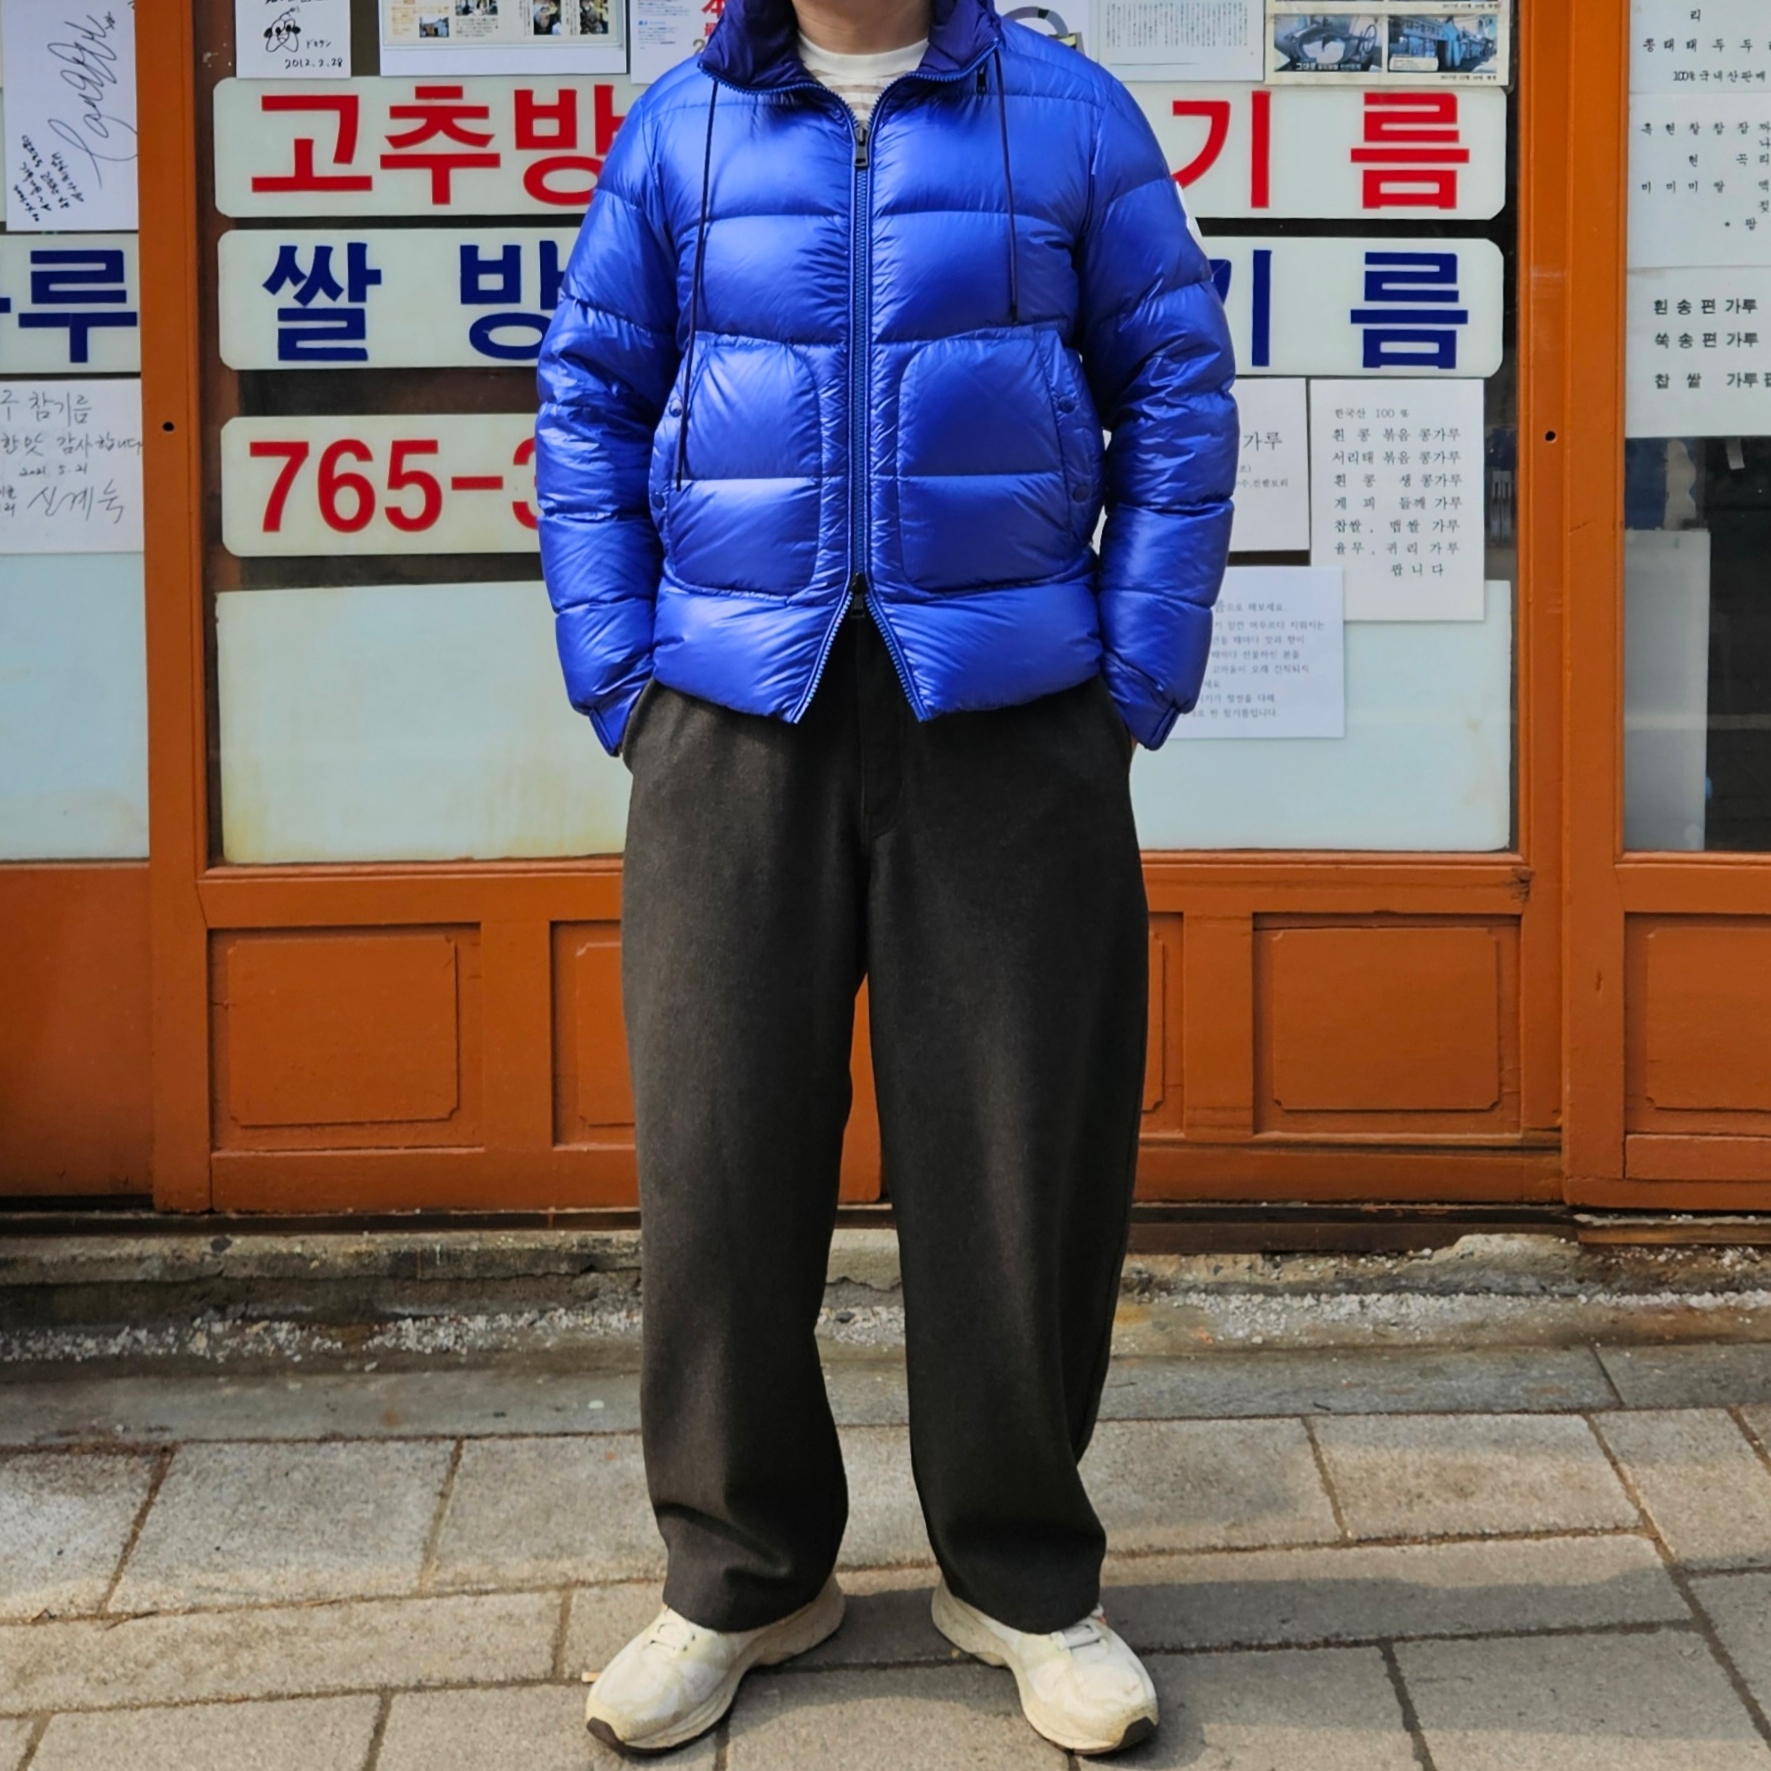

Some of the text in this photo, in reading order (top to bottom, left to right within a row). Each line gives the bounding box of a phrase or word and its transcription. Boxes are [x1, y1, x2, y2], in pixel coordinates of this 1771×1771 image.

[252, 85, 627, 206] 고추방
[0, 250, 138, 363] 루
[28, 391, 92, 427] 참기름
[1335, 408, 1366, 419] 한국산
[1375, 408, 1395, 418] 100
[1243, 431, 1283, 452] 가루
[1357, 428, 1371, 442] 콩
[1383, 428, 1410, 442] 볶음
[1419, 428, 1461, 442] 콩가루
[57, 431, 143, 460] 감사합니다
[1332, 451, 1461, 465] 서리태 볶음 콩가루
[1363, 474, 1376, 488] 콩
[1400, 474, 1411, 488] 생
[1421, 474, 1463, 488] 콩가루
[1435, 496, 1463, 511] 가루
[1432, 519, 1461, 534] 가루
